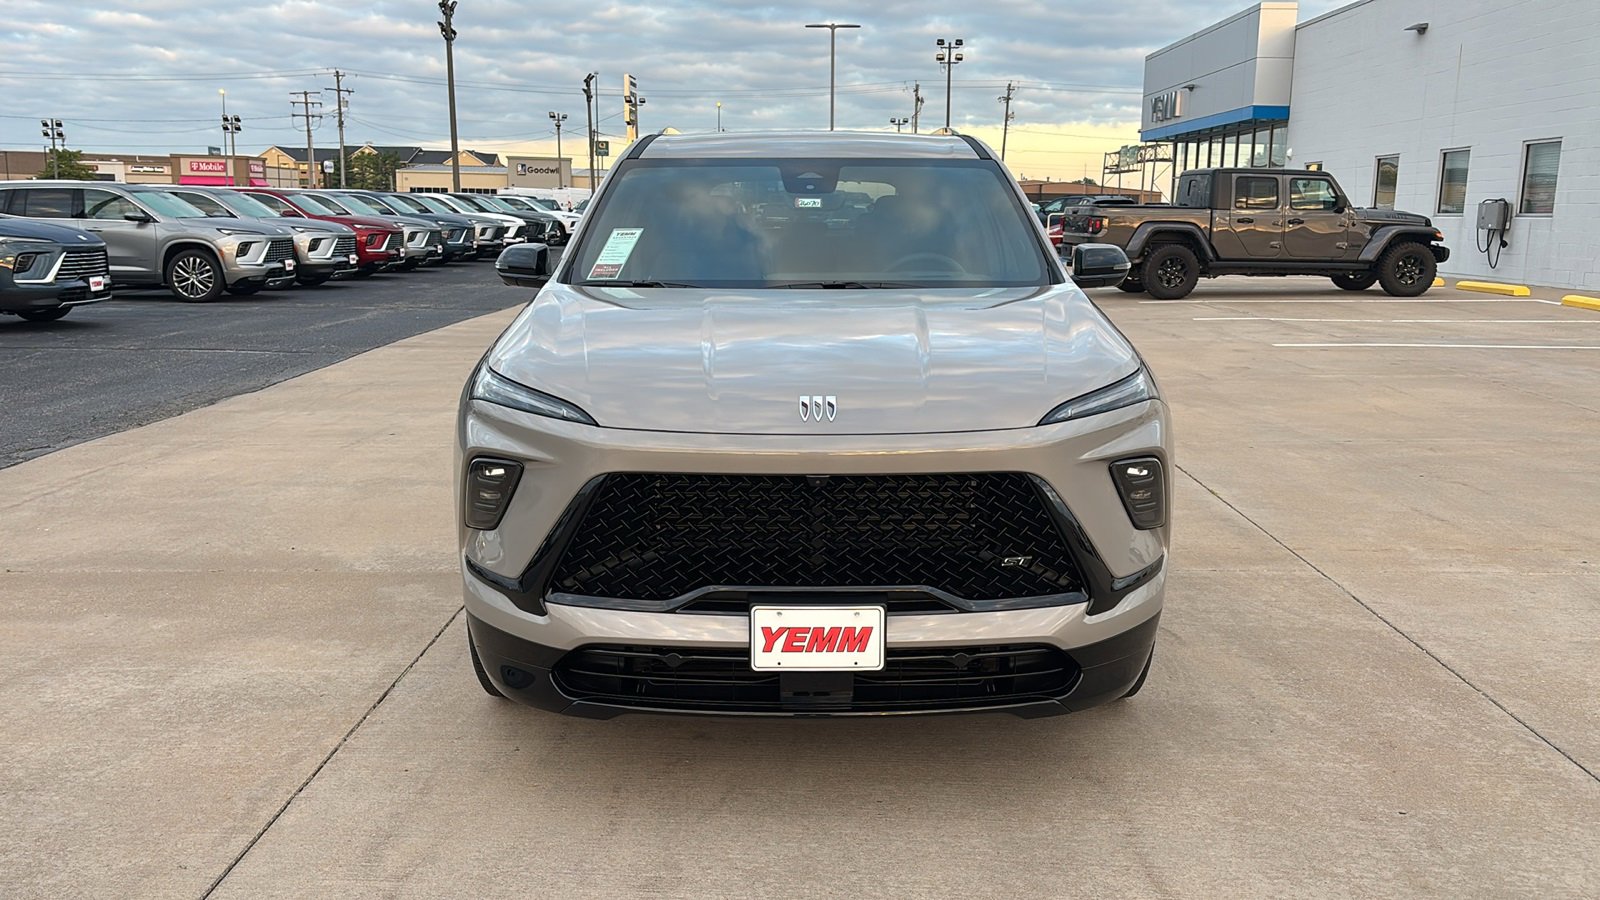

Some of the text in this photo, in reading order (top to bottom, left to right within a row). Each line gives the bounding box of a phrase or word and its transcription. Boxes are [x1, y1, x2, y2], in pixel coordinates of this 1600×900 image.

[199, 162, 224, 171] Mobile
[527, 166, 560, 174] Goodwil
[761, 627, 873, 653] YEMM
